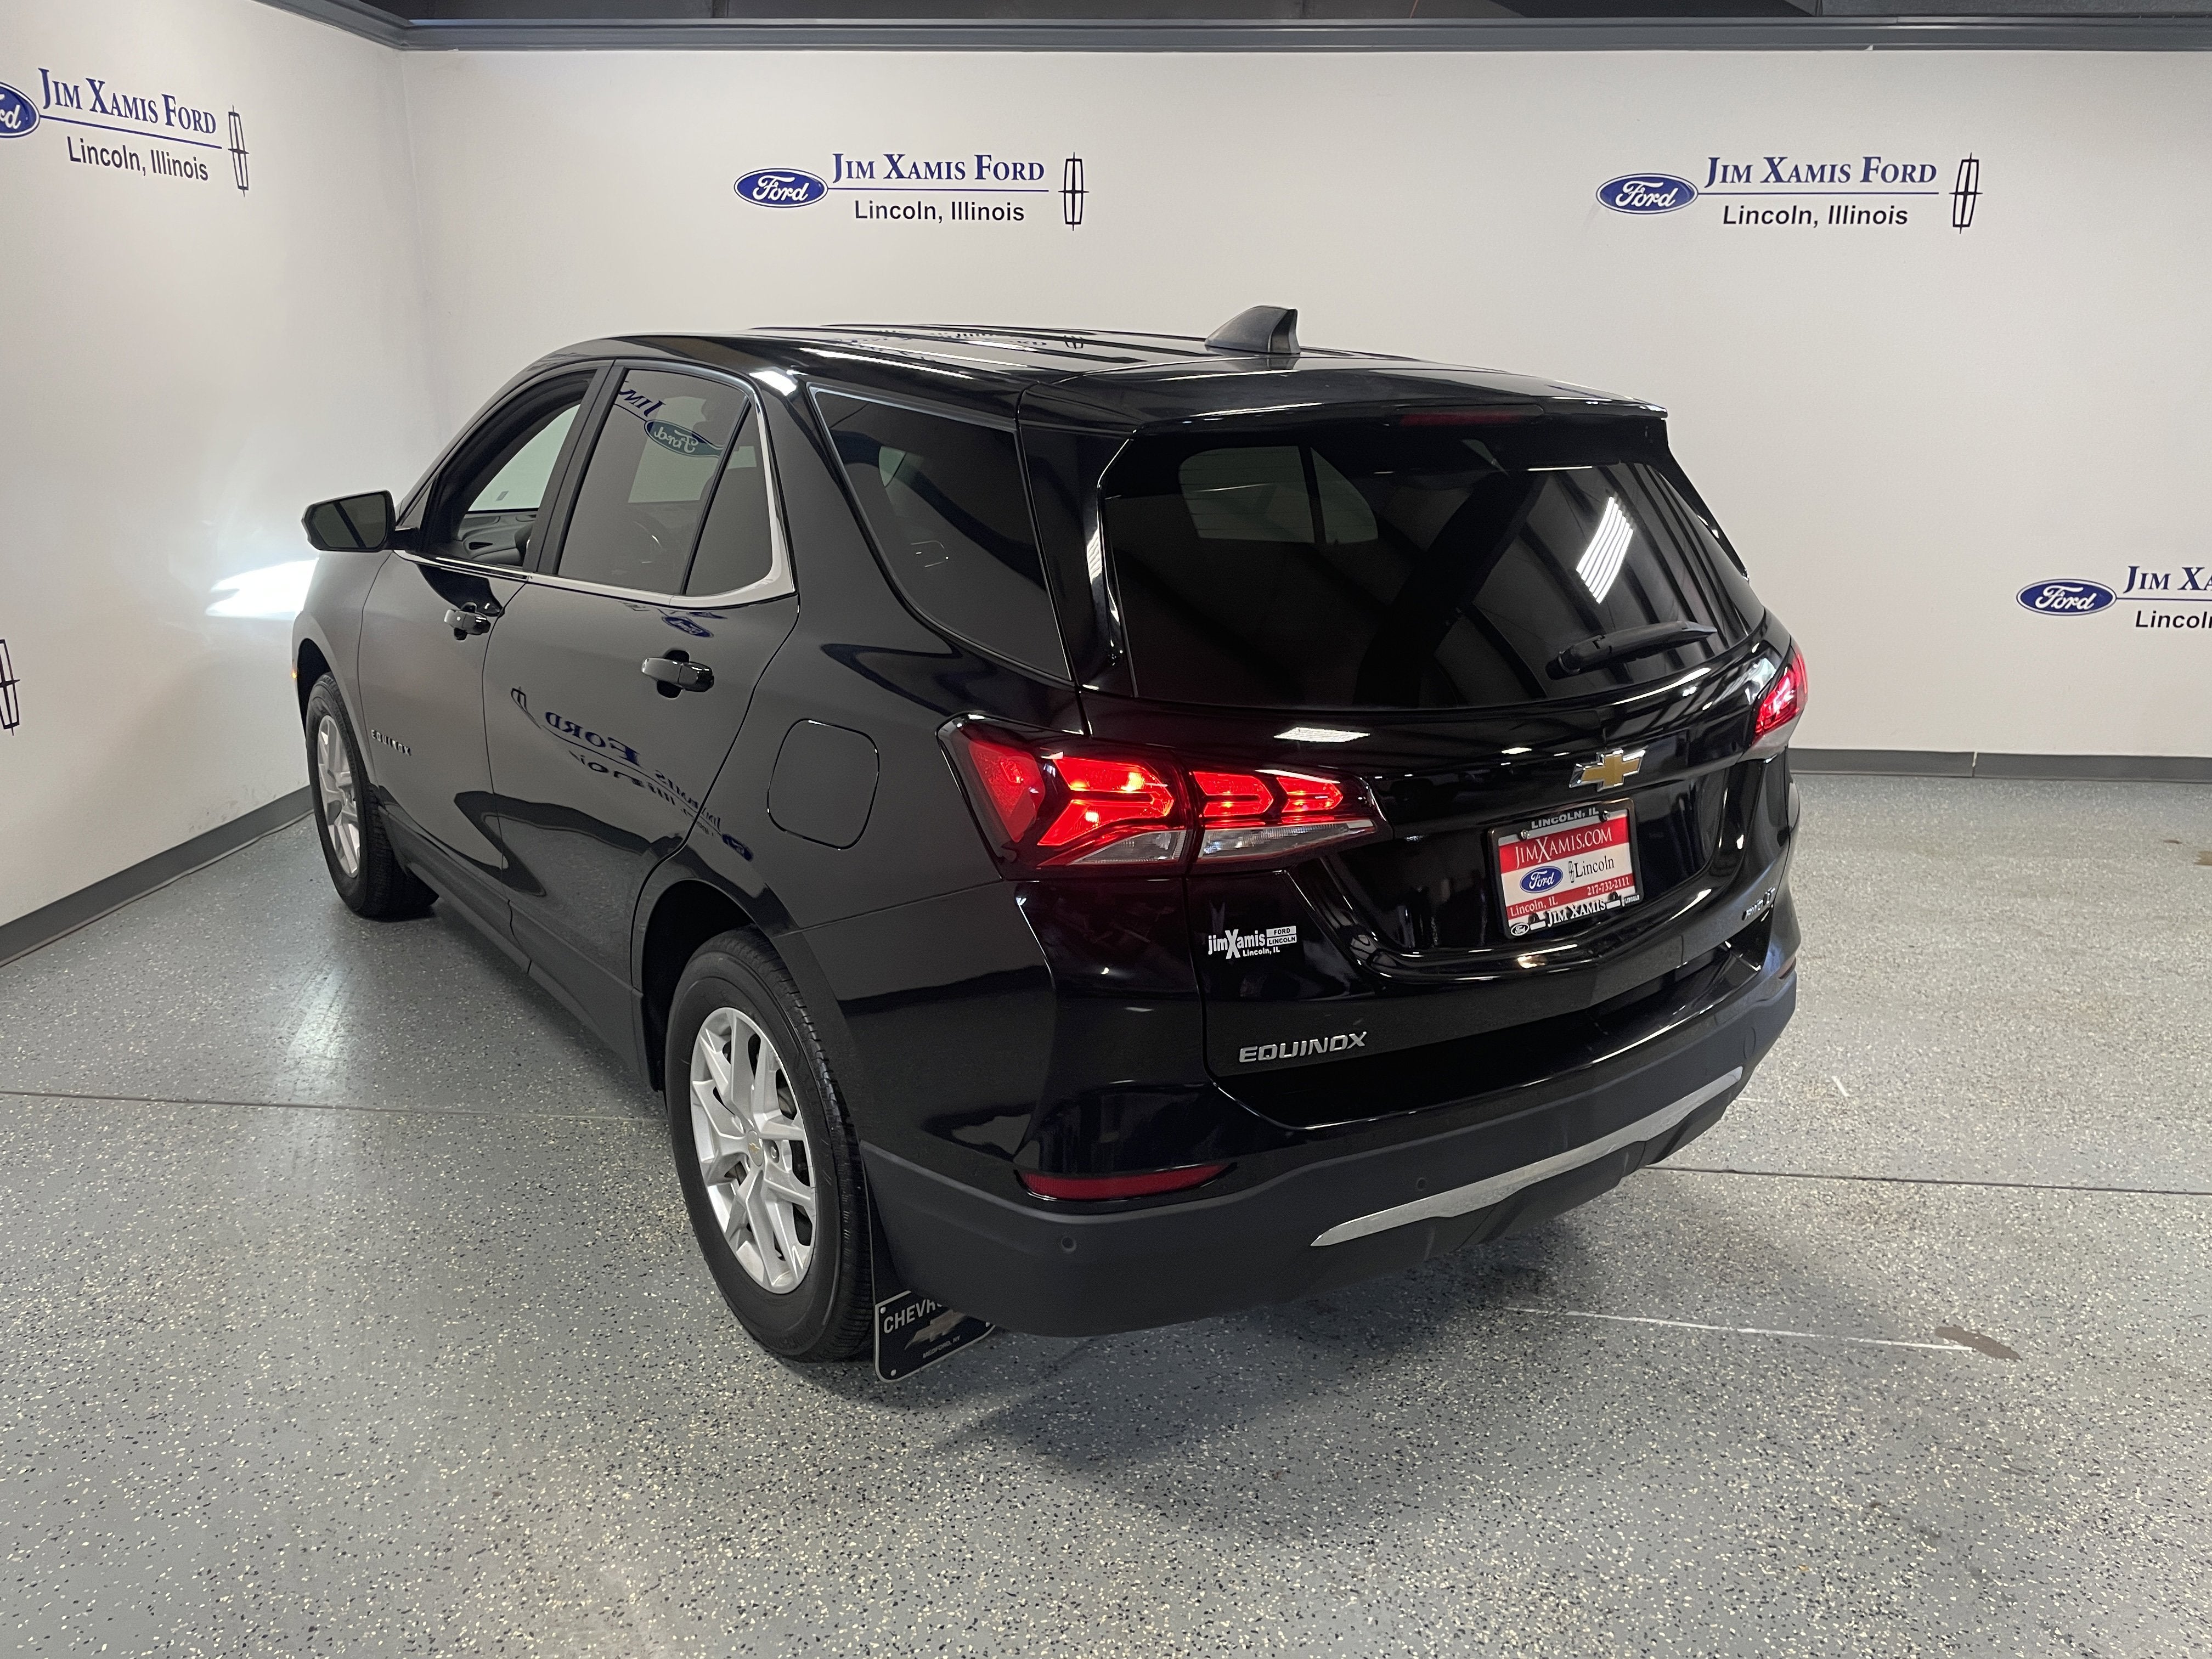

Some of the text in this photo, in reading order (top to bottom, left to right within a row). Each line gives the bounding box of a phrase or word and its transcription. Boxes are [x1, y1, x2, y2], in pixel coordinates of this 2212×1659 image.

[38, 67, 217, 134] JIM XAMIS FORD
[66, 136, 209, 181] Lincoln, Illinois
[832, 153, 1045, 184] JIM XAMIS FORD
[1704, 156, 1937, 188] JIM XAMIS FORD
[752, 175, 809, 202] Ford
[1615, 180, 1678, 207] Ford
[854, 200, 1025, 224] Lincoln, Illinois
[1722, 205, 1908, 228] Lincoln, Illinois
[2123, 566, 2171, 594] JIM
[2035, 585, 2097, 611] Ford
[1531, 807, 1599, 830] LINCOLN, IL
[1515, 827, 1612, 869] JIMXAMIS.COM
[1528, 870, 1555, 889] Ford
[1574, 855, 1615, 878] Lincoln
[1587, 876, 1630, 896] 217-732-2111
[1510, 896, 1558, 917] Lincoln, IL
[1547, 900, 1606, 927] JIM XAMIS
[1243, 947, 1272, 957] Lincoln,
[1268, 936, 1296, 945] LINCOLN
[1239, 1031, 1367, 1063] EQUINOX
[883, 1299, 943, 1334] CHEVR
